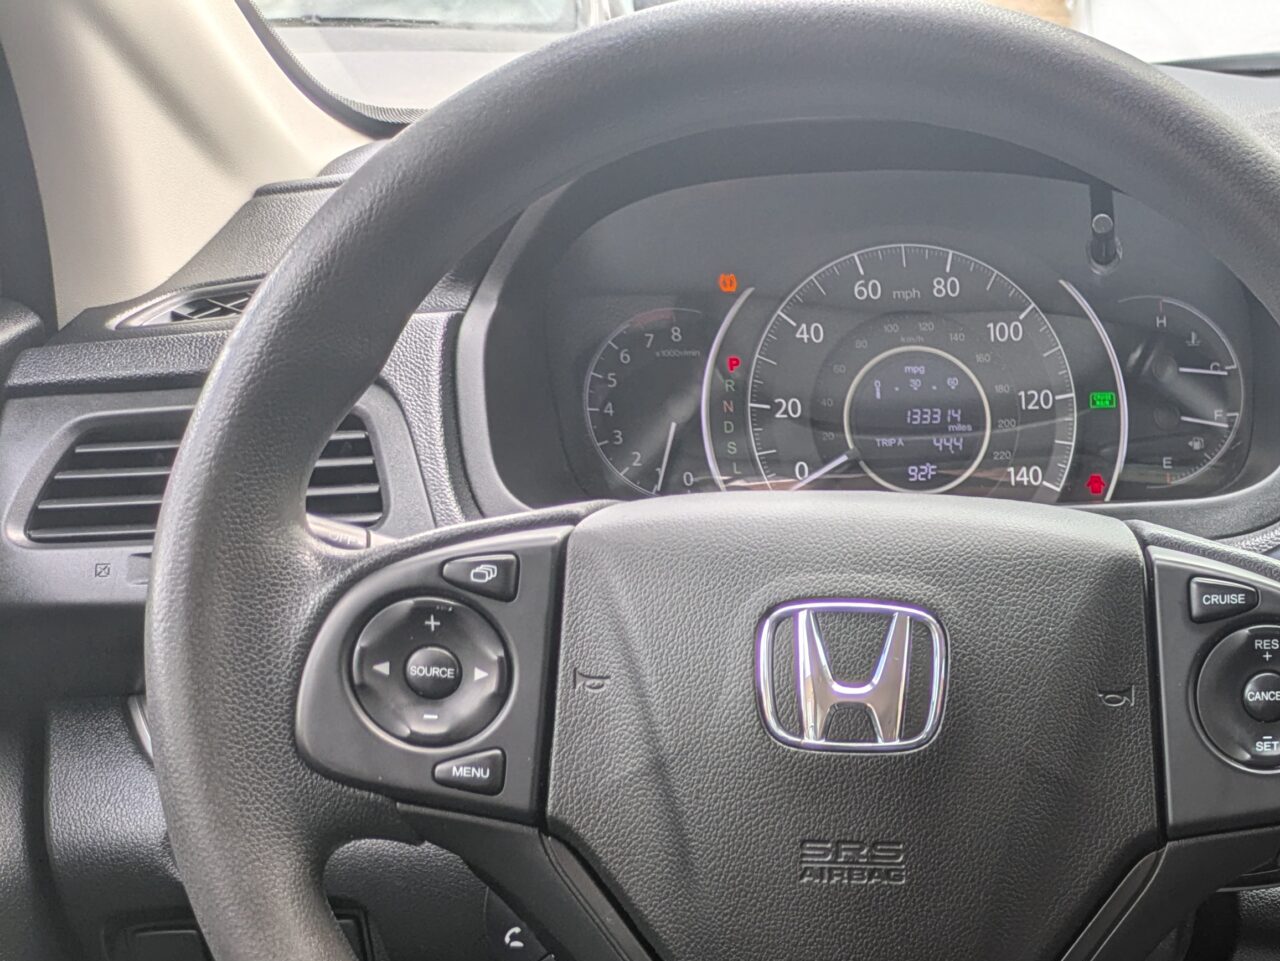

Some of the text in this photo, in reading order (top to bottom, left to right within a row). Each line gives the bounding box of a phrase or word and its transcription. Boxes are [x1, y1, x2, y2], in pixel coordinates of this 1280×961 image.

[854, 279, 881, 300] 60
[892, 288, 921, 300] mph
[933, 277, 960, 298] 80
[1156, 316, 1167, 328] H
[671, 327, 682, 341] 8
[795, 323, 824, 343] 40
[987, 321, 1023, 342] 100
[644, 334, 654, 348] 7
[619, 349, 631, 364] 6
[727, 356, 741, 372] P
[904, 365, 925, 375] mpg
[607, 373, 617, 387] 5
[725, 379, 735, 392] R
[724, 401, 734, 413] N
[1018, 390, 1054, 410] 120
[603, 402, 614, 416] 4
[774, 398, 802, 418] 20
[1214, 409, 1224, 421] F
[724, 421, 734, 433] D
[948, 423, 972, 432] miles
[613, 430, 623, 444] 3
[876, 438, 896, 447] TRIP
[727, 442, 737, 454] S
[632, 452, 642, 466] 2
[1163, 457, 1173, 468] E
[733, 462, 741, 474] L
[794, 461, 809, 481] 0
[683, 472, 694, 486] 0
[1007, 465, 1043, 486] 140
[1202, 594, 1246, 605] CRUISE
[1255, 639, 1280, 651] RES
[410, 665, 455, 679] SOURCE
[1256, 741, 1280, 752] SET
[452, 766, 490, 778] MENU
[801, 841, 905, 863] SRS
[801, 868, 907, 885] AIRBAG
